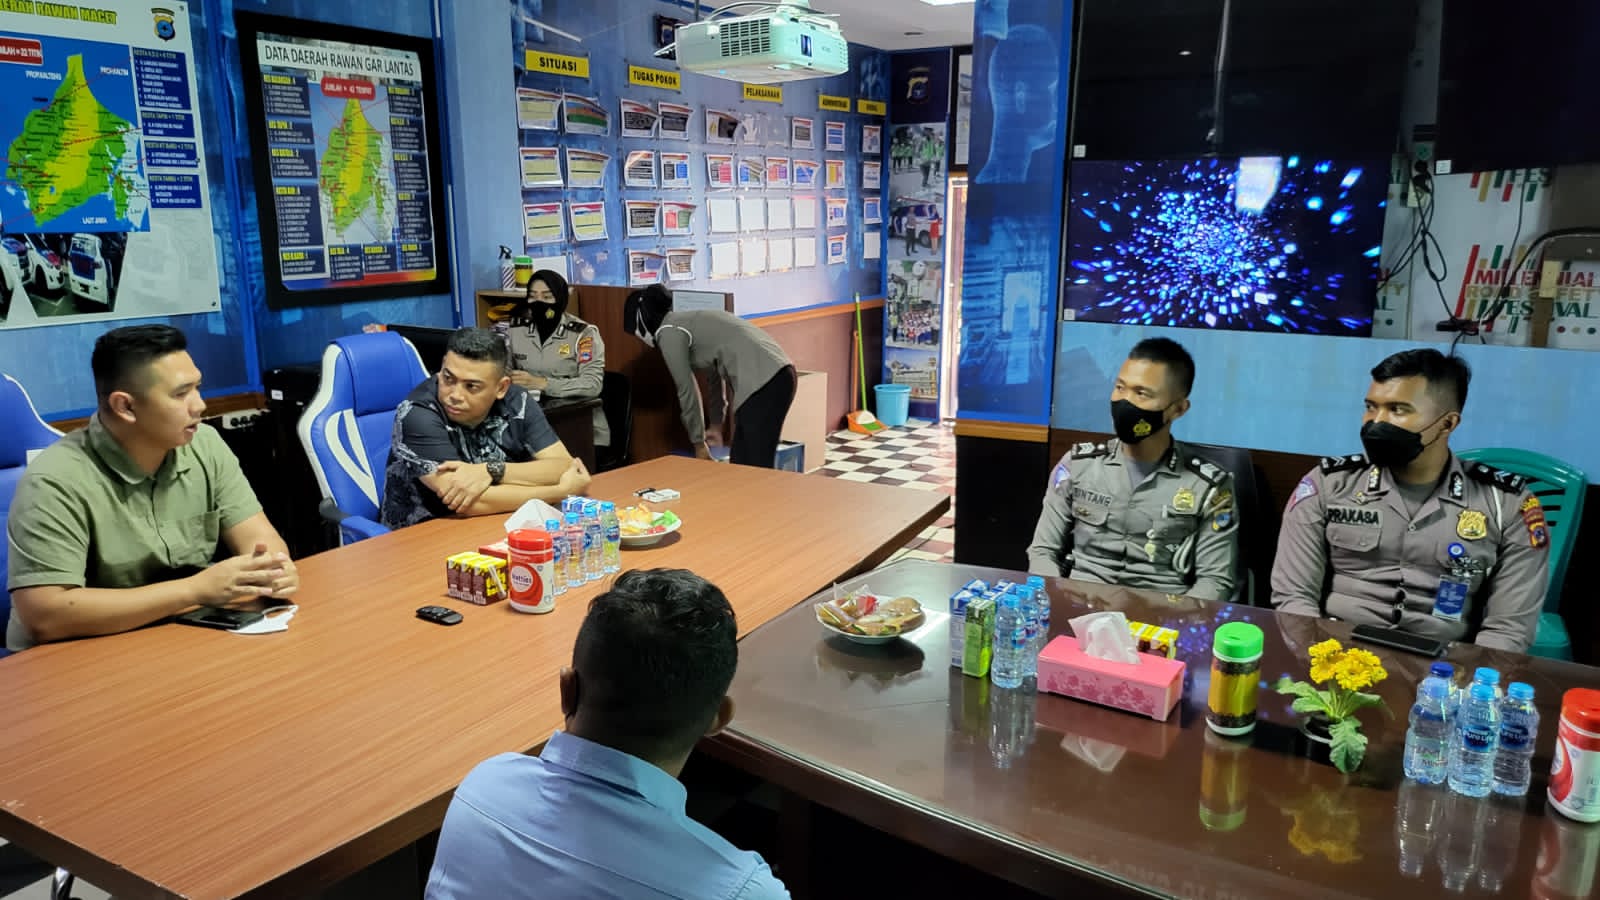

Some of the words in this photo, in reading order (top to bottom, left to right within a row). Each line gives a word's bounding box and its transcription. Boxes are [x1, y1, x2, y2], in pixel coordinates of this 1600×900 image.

[36, 1, 79, 20] RAWAN
[80, 6, 117, 25] MACET
[264, 45, 290, 62] DATA
[292, 49, 329, 66] DAERAH
[330, 54, 364, 71] RAWAN
[365, 60, 383, 73] GAR
[384, 61, 414, 76] LANTAS
[539, 57, 577, 72] SITUASI
[633, 71, 654, 82] TUGAS
[655, 73, 677, 85] POKOK
[1328, 508, 1380, 525] PRAKASA
